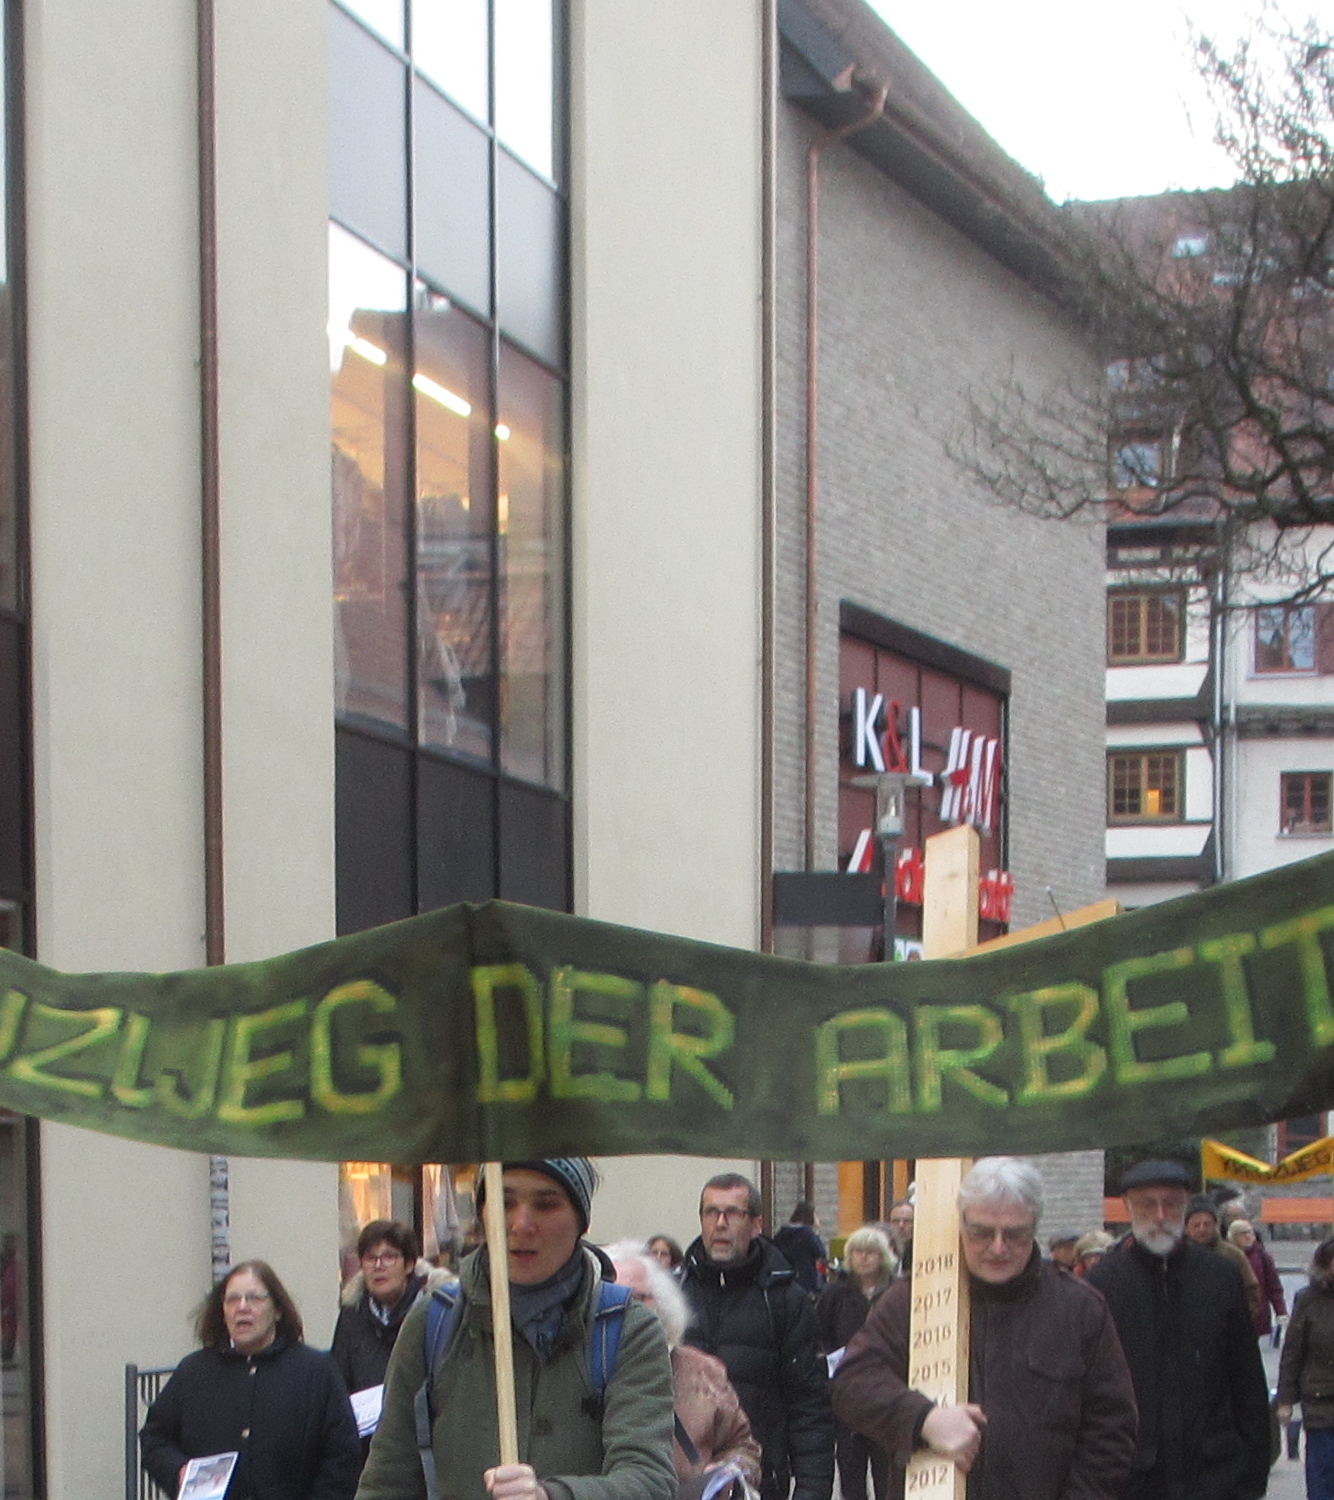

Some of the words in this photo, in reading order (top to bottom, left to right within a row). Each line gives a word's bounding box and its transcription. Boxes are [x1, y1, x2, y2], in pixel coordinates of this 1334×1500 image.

[853, 686, 934, 786] K&L
[471, 963, 735, 1111] DER
[914, 1252, 954, 1278] 2018
[913, 1288, 952, 1314] 2017
[913, 1325, 952, 1349] 2016
[911, 1360, 951, 1385] 2015
[908, 1467, 948, 1492] 2012
